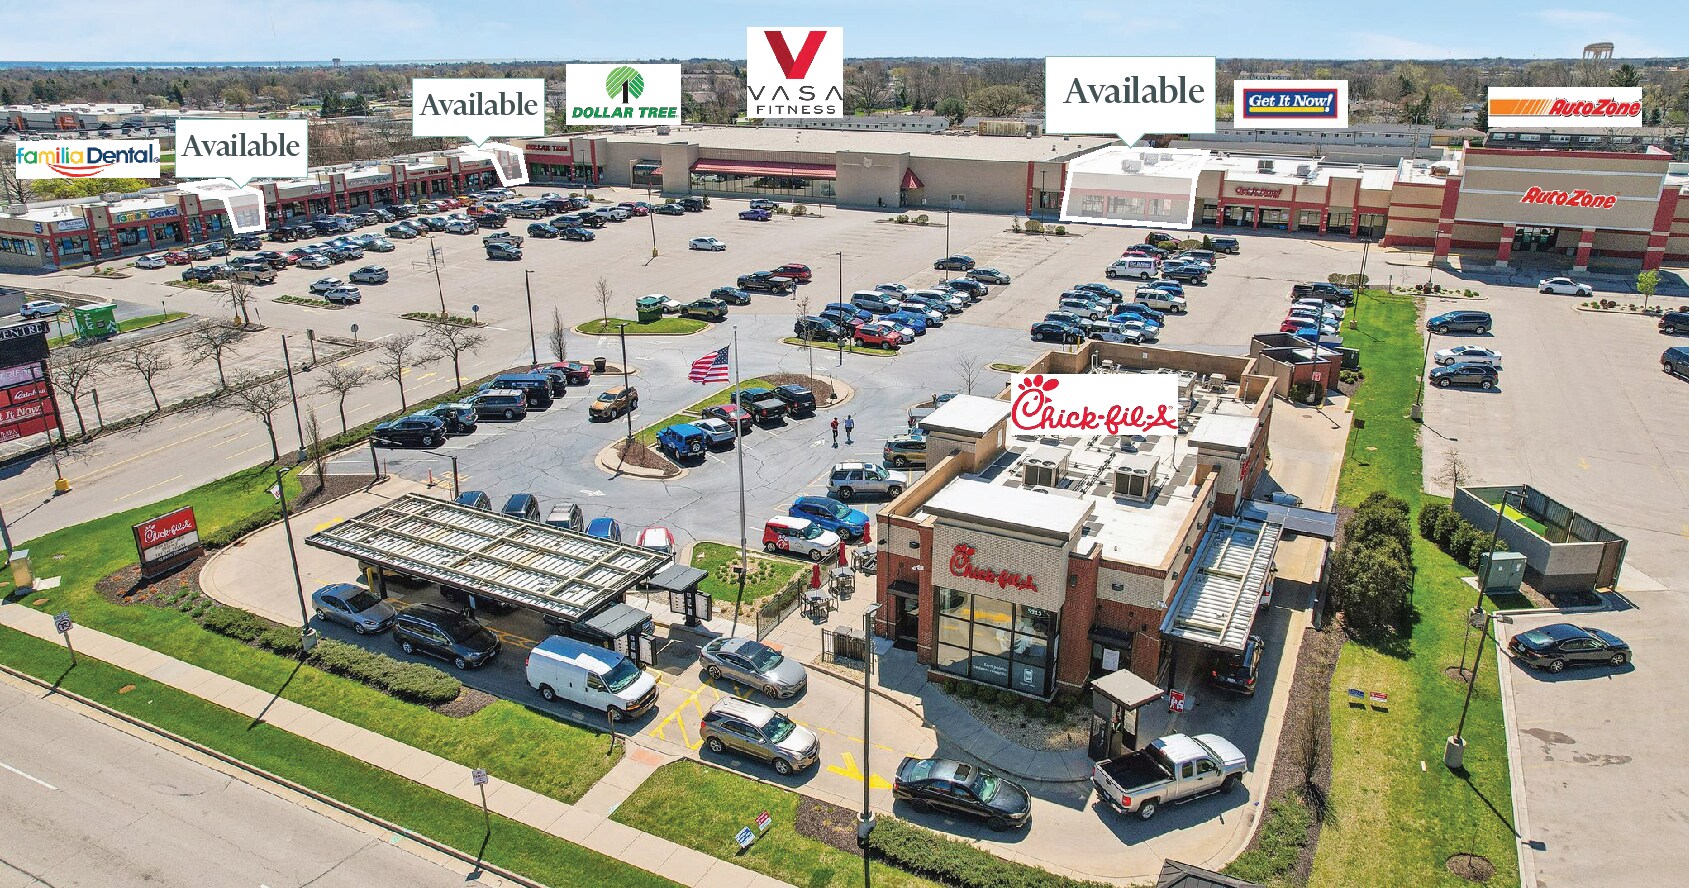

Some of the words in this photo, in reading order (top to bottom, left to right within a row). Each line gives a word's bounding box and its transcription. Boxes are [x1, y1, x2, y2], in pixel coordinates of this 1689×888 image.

[1520, 186, 1617, 209] AutoZone
[149, 208, 177, 218] Dental
[950, 547, 1038, 592] Chick-fil-A
